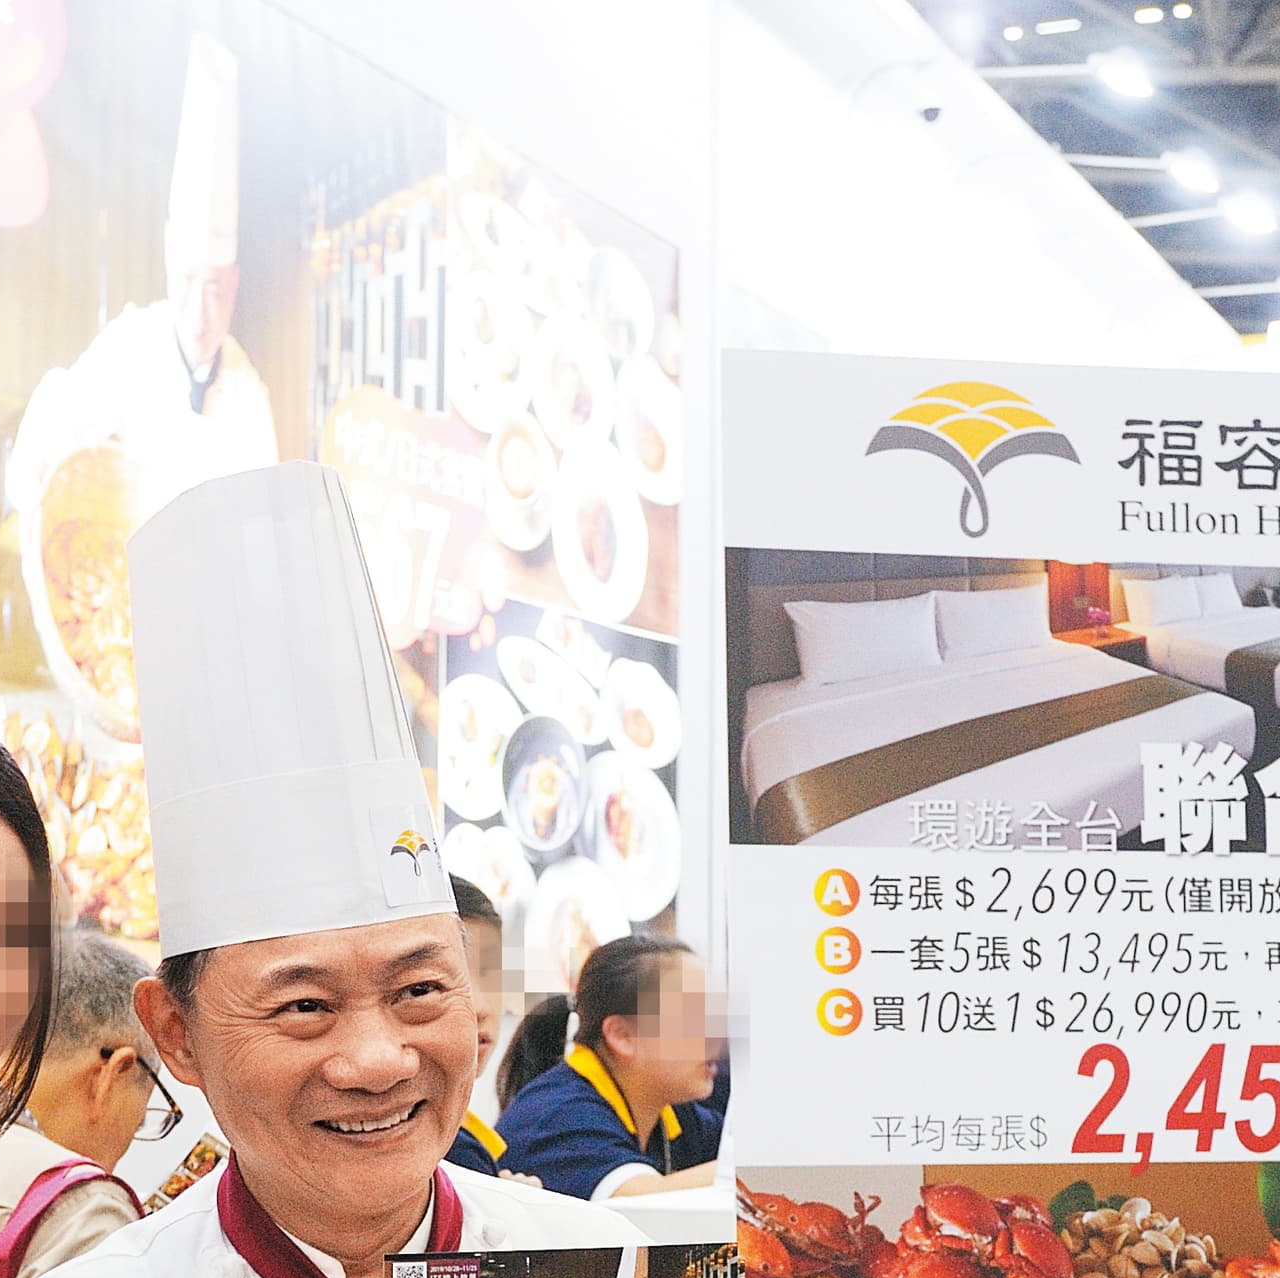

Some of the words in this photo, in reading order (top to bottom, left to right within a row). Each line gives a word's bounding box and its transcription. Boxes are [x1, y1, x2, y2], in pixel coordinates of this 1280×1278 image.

[1118, 499, 1239, 535] Fullon
[907, 799, 1124, 858] 環遊全台
[870, 1113, 1048, 1154] 平均每張$
